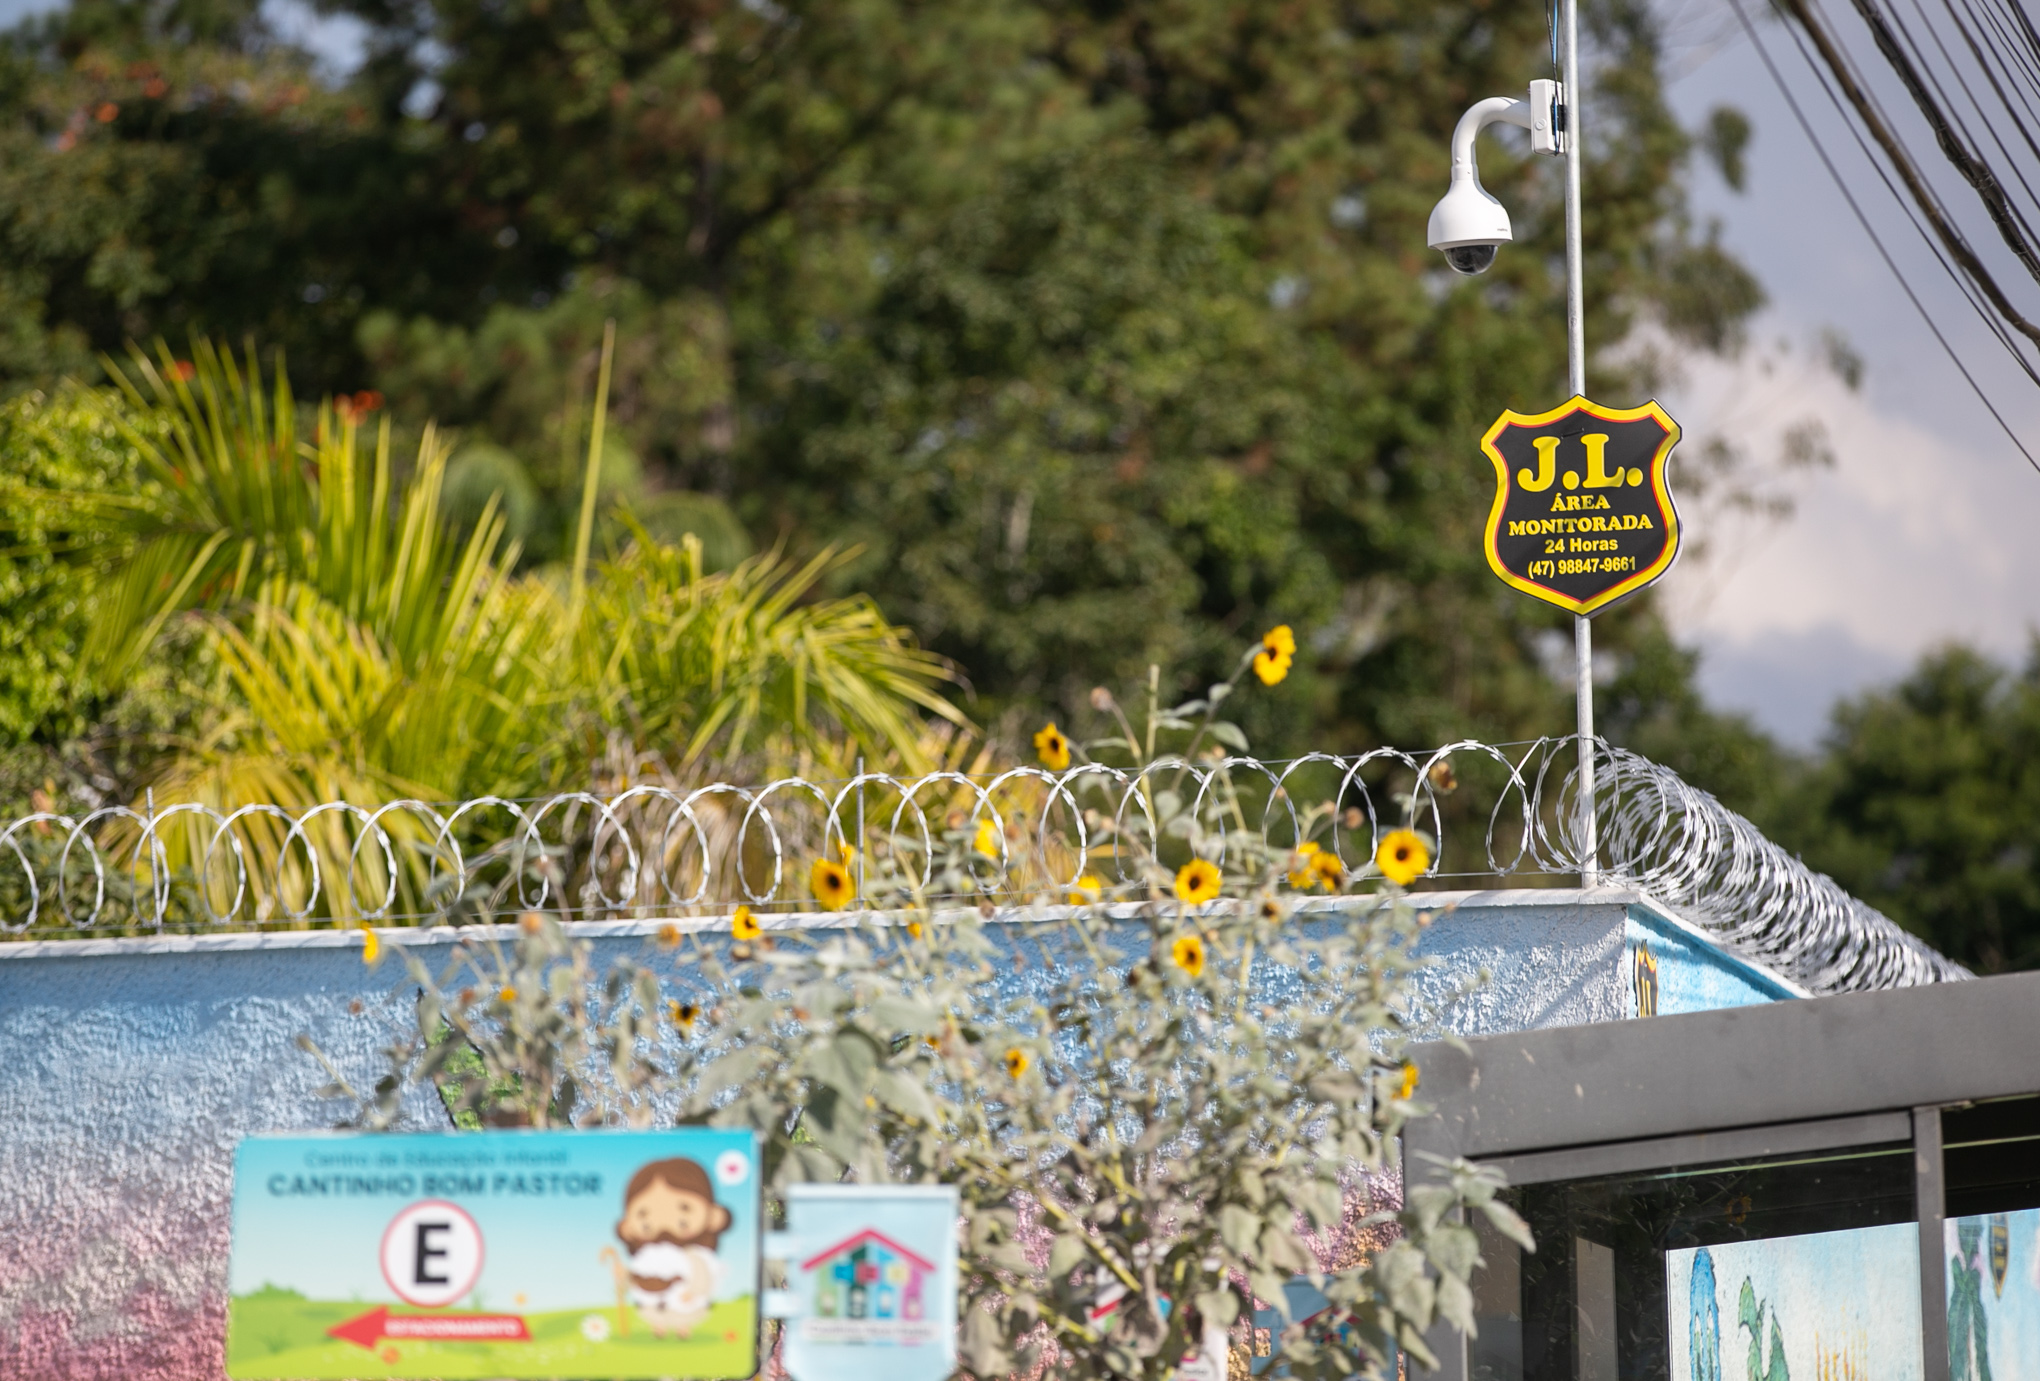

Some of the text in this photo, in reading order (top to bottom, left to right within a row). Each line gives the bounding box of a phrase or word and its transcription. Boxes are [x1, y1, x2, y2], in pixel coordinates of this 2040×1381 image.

[1517, 433, 1644, 492] J.L.
[1550, 492, 1611, 512] ÁREA
[1508, 514, 1654, 536] MONITORADA
[1544, 537, 1618, 554] 24 Horas
[1528, 556, 1636, 580] (47) 98847-9661
[267, 1171, 601, 1197] CANTINHO BOM PASTOR
[412, 1222, 452, 1286] E
